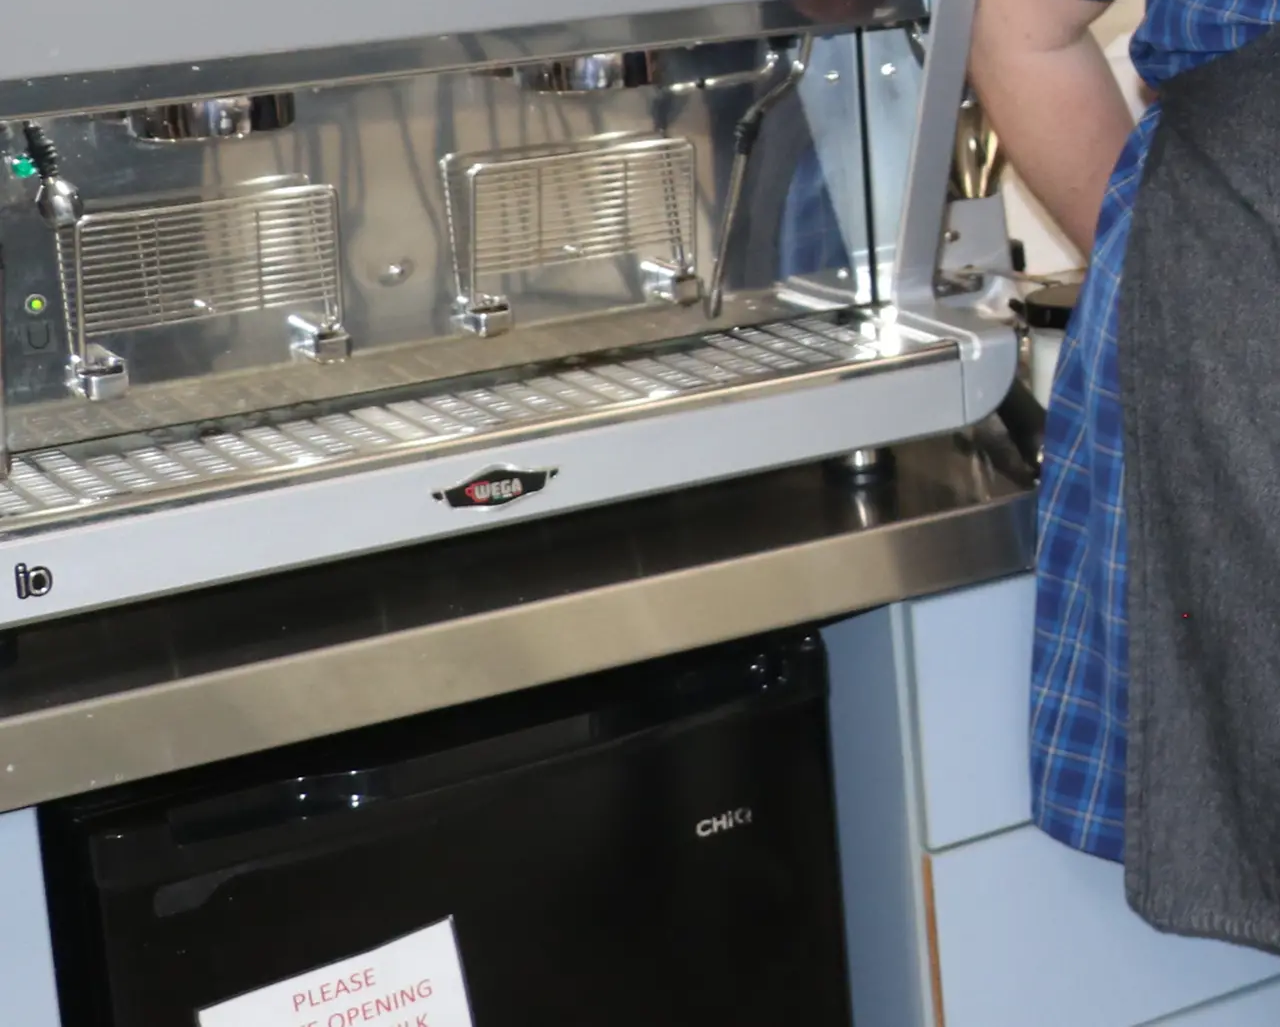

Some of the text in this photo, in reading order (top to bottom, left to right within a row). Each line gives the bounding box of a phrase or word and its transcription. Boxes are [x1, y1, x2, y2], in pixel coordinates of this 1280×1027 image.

[473, 477, 523, 501] WEGA
[292, 967, 376, 1012] PLEASE
[327, 978, 433, 1027] OPENING
